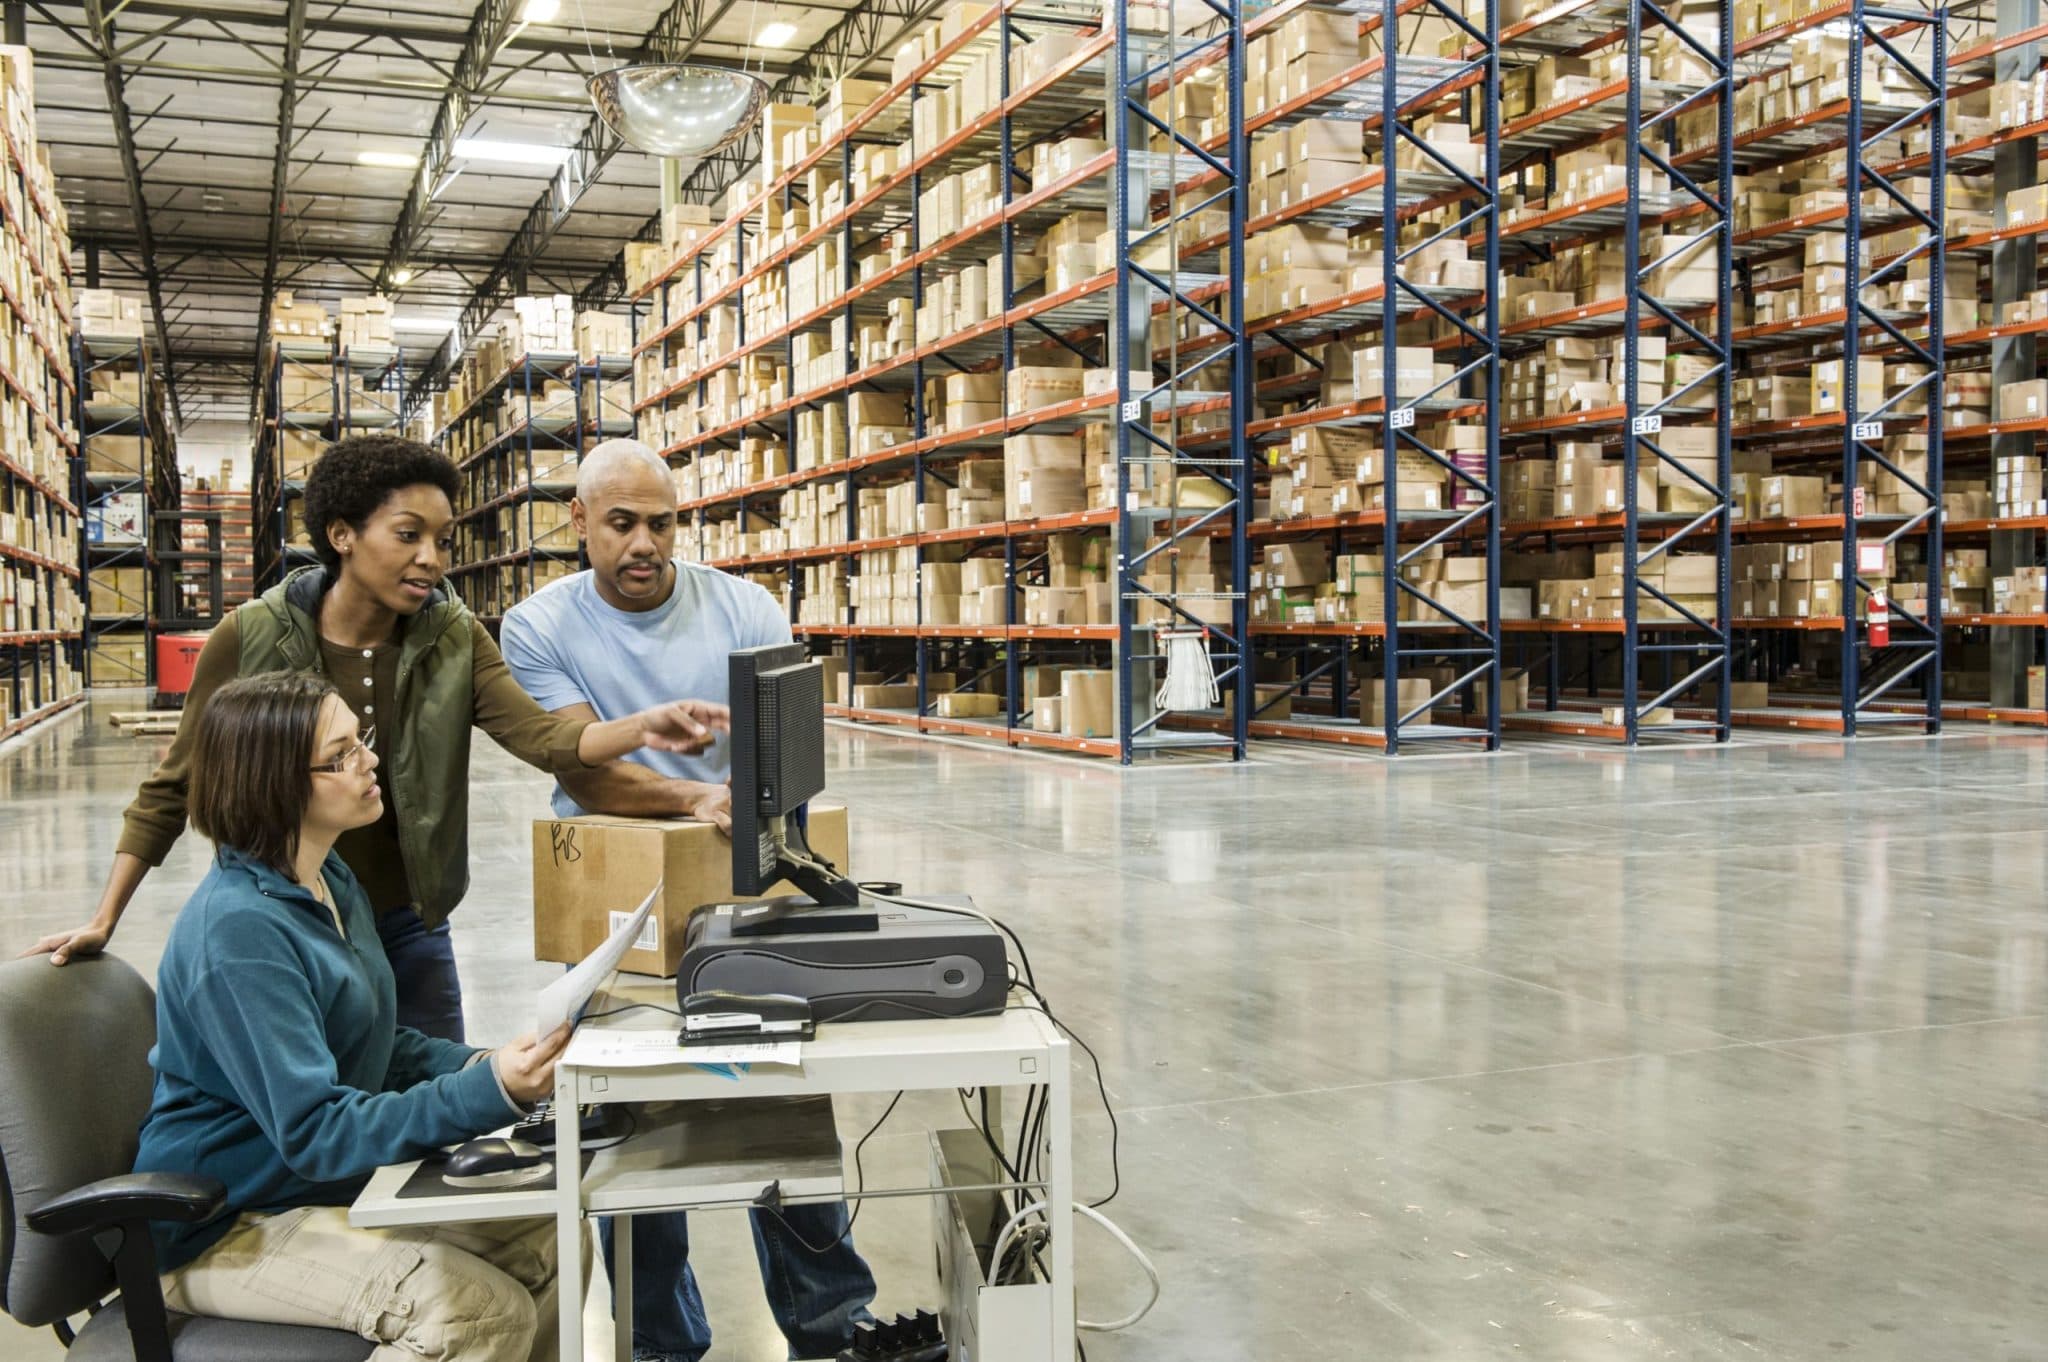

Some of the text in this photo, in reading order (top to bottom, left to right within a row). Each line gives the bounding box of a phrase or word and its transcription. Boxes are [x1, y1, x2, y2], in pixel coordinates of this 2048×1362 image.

[1392, 410, 1412, 426] E13
[1634, 417, 1659, 432] E12
[1856, 424, 1878, 438] E11
